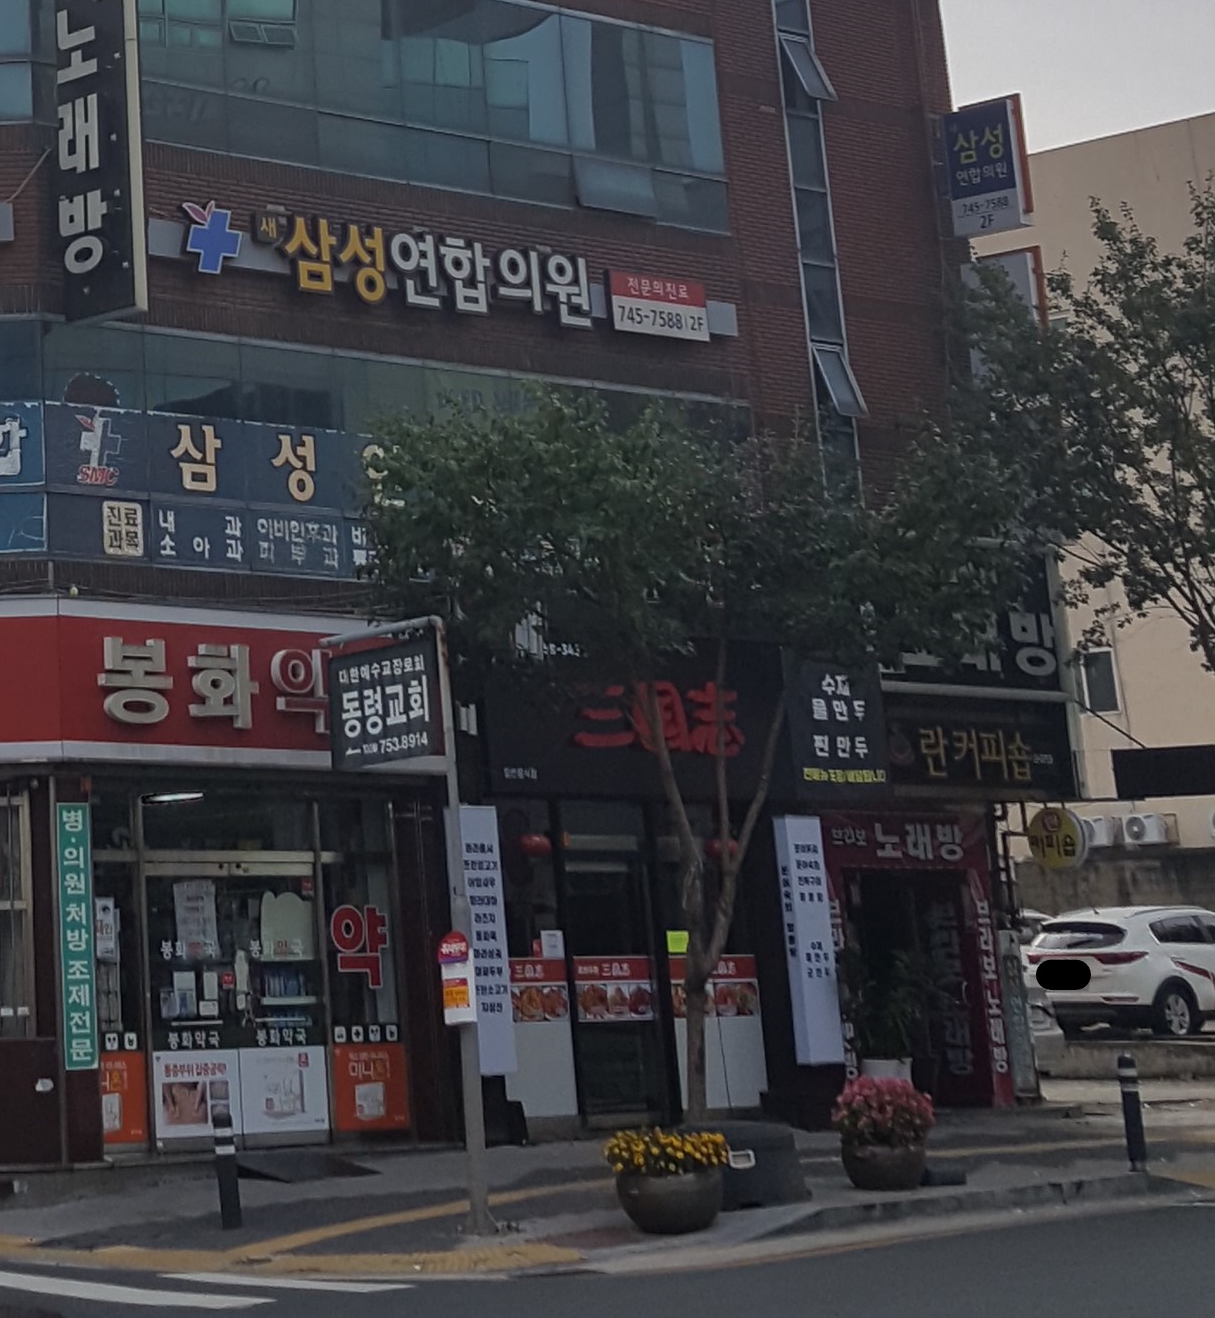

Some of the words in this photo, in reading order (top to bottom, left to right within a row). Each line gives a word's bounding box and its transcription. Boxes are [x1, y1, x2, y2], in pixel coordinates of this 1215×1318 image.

[954, 123, 1004, 165] 삼성
[956, 161, 1008, 187] 연합의원
[980, 213, 995, 229] 2F
[618, 305, 683, 330] 745-7588
[689, 316, 704, 331] 2F
[257, 518, 338, 545] 이비인후과
[338, 654, 425, 684] 대한예수교장로회
[341, 675, 429, 738] 동령교회
[875, 822, 964, 861] 노래방
[330, 905, 388, 989] 약
